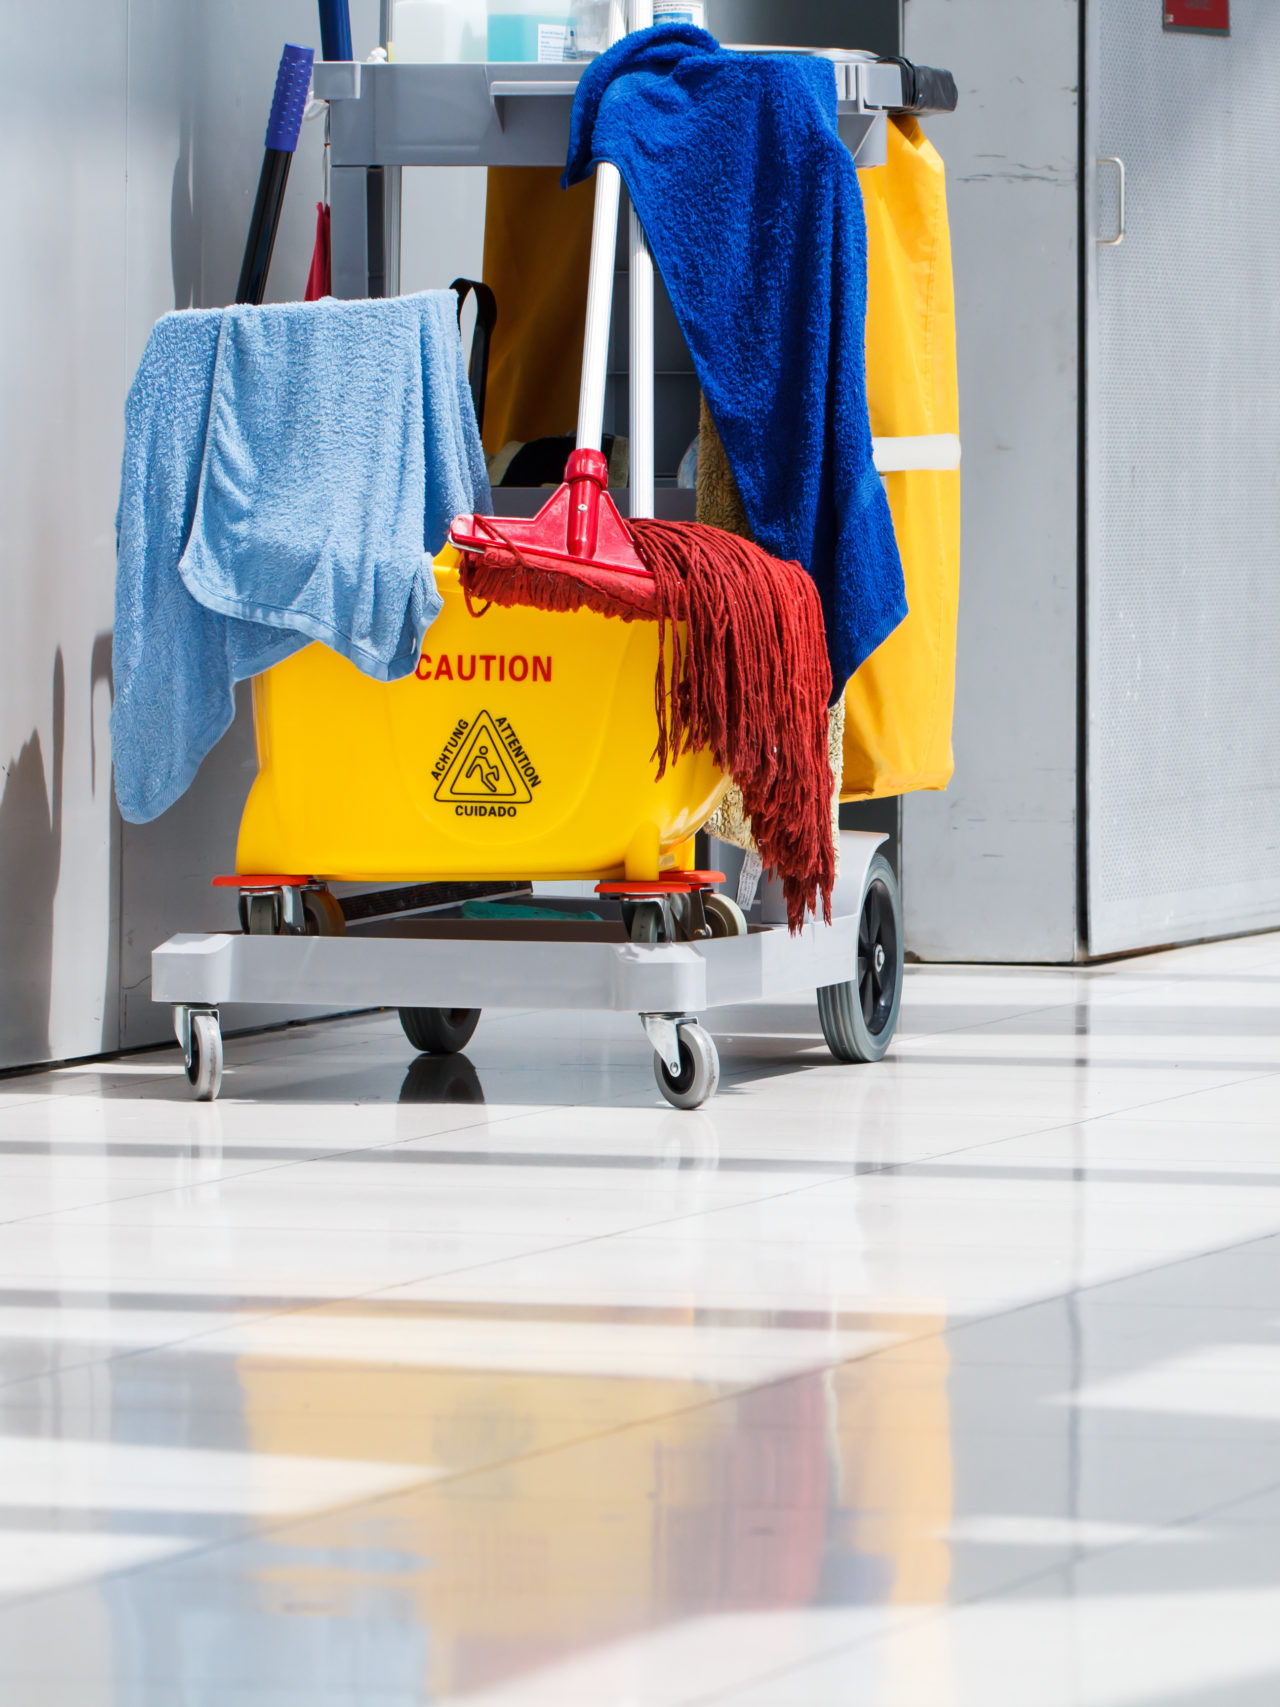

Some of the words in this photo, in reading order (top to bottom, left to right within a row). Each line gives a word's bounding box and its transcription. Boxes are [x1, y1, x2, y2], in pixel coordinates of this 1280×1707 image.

[415, 654, 552, 682] CAUTION
[430, 718, 469, 781] ACHTUNG
[495, 717, 542, 788] ATTENTION
[455, 804, 517, 817] CUIDADO
